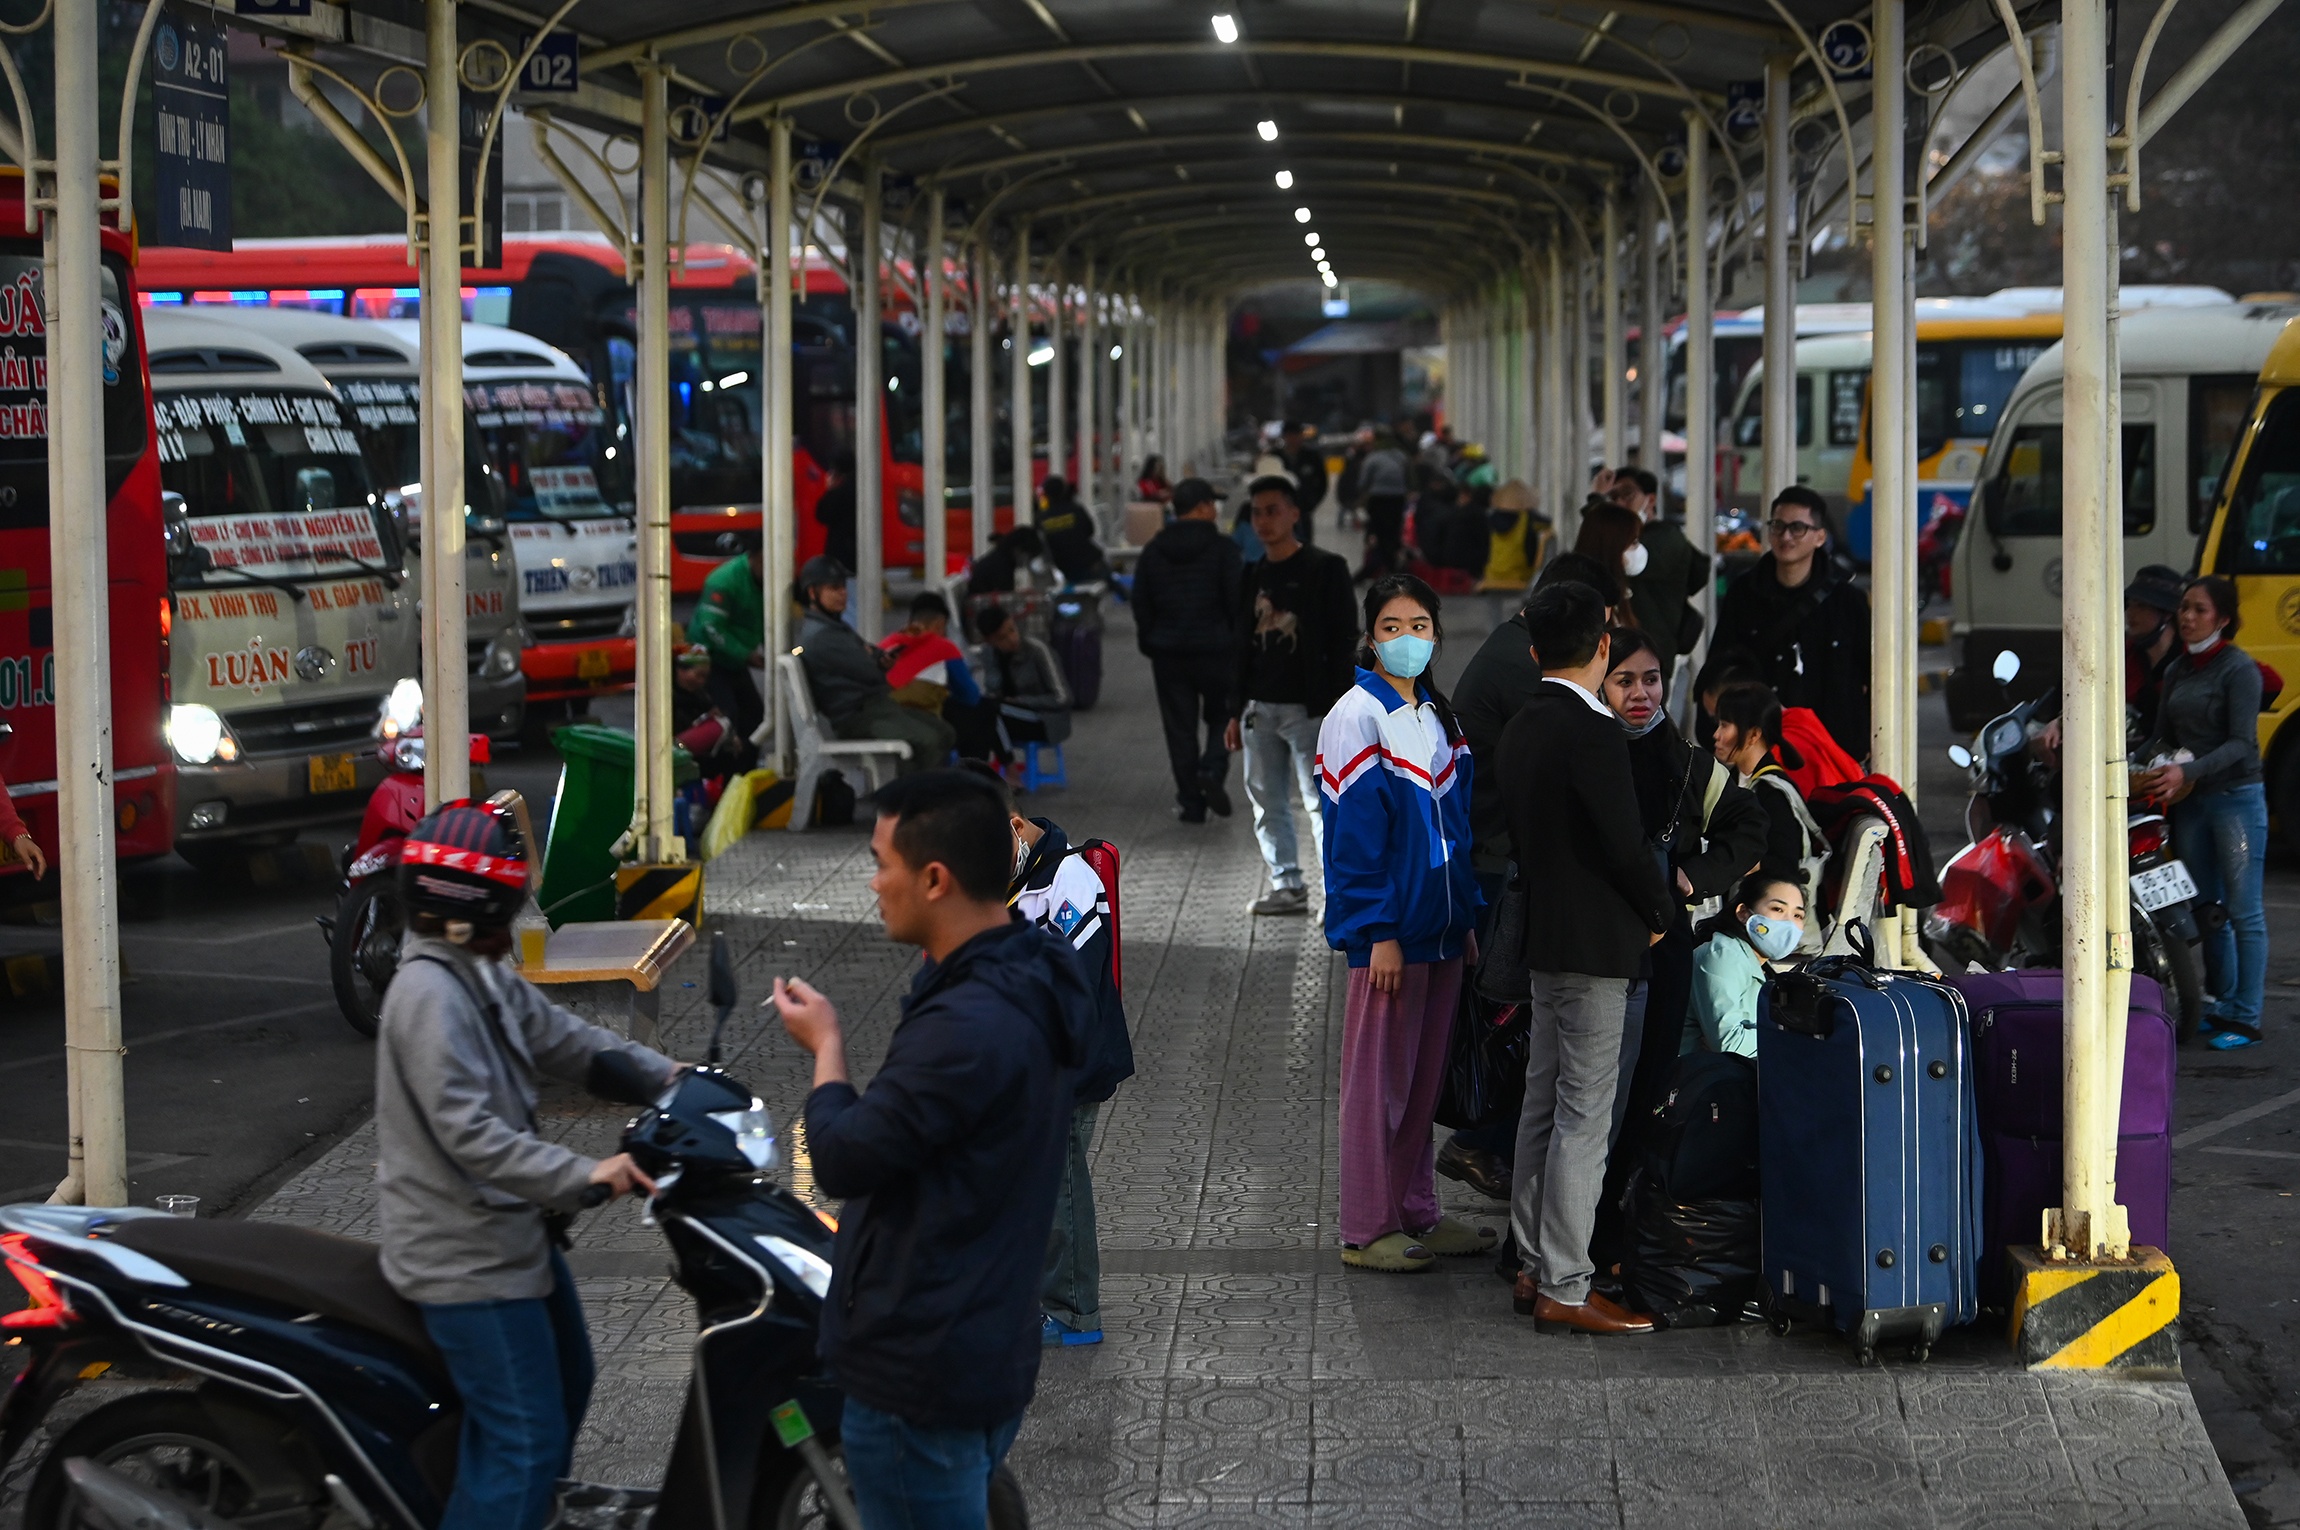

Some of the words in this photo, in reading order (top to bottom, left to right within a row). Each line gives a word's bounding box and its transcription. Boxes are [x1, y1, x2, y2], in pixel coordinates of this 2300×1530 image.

[530, 53, 573, 87] 02
[179, 594, 209, 622] BX.
[208, 589, 249, 620] VĨNH
[246, 588, 280, 622] TRỤ
[308, 586, 335, 612] BX.
[206, 637, 292, 696] LUẬN
